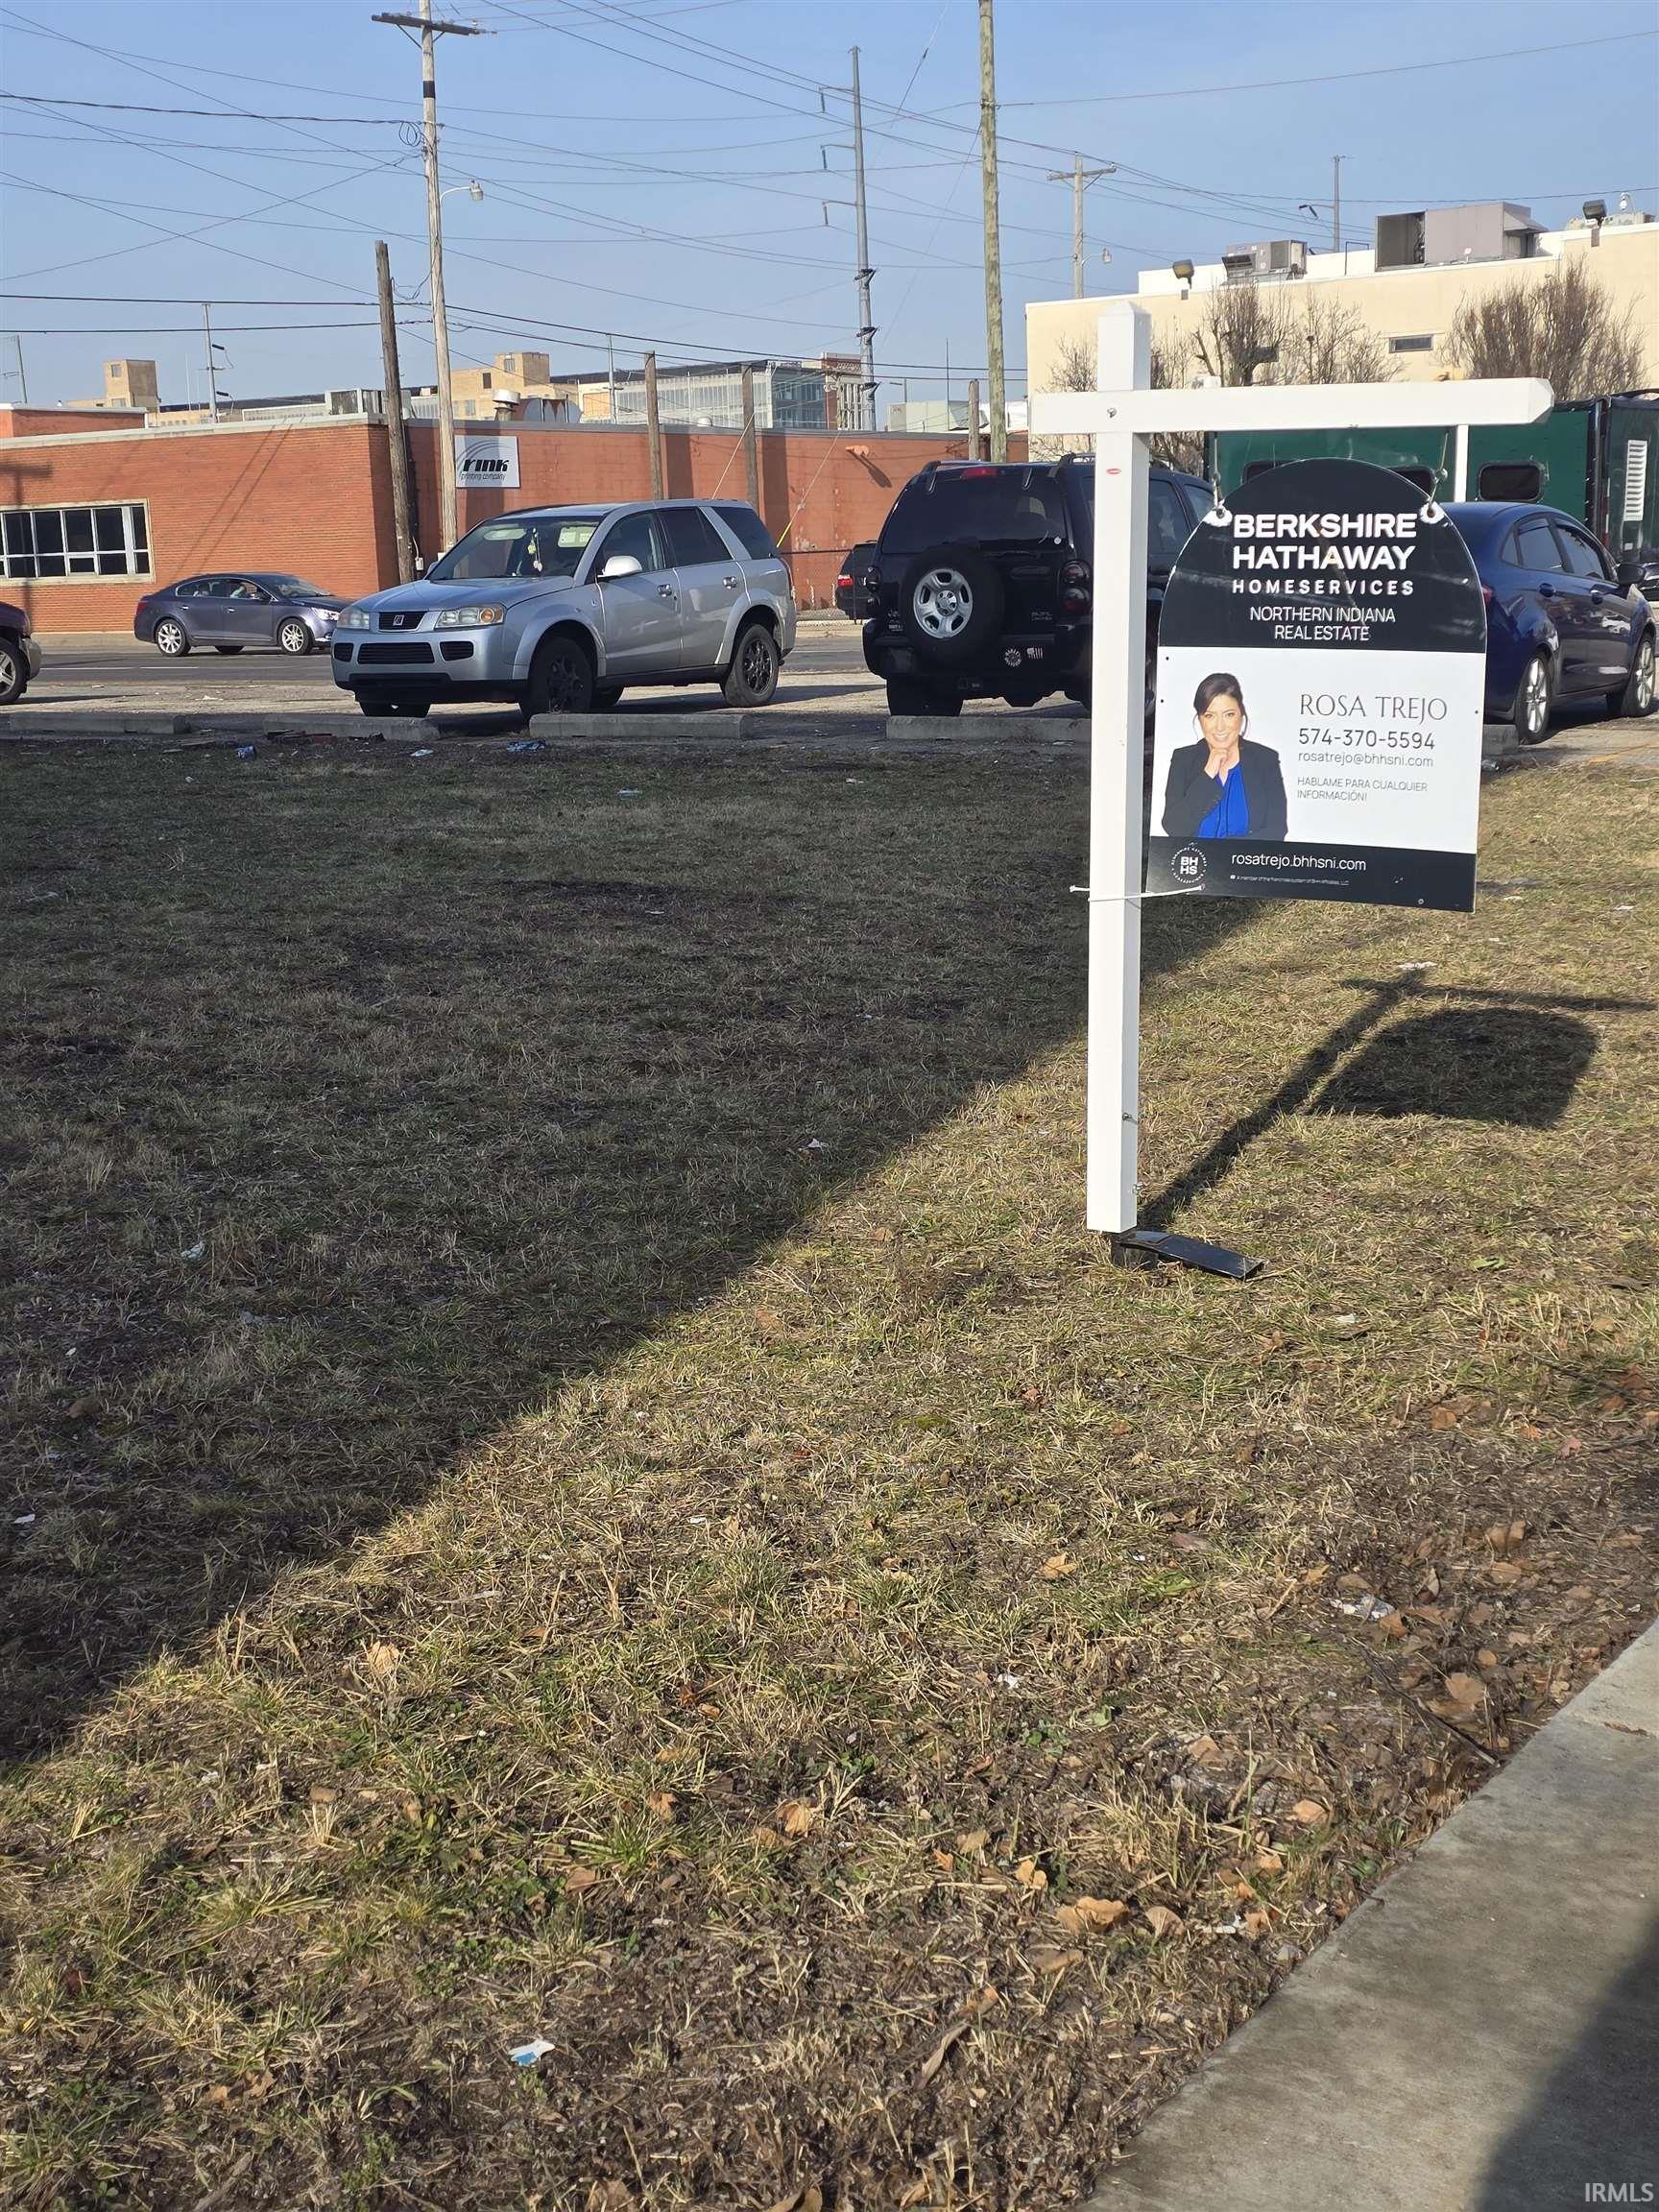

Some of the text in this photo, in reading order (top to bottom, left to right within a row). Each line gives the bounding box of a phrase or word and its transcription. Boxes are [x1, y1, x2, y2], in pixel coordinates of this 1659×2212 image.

[1234, 514, 1417, 539] BERKSHIRE
[1233, 545, 1416, 570] HATHAWAY
[1233, 579, 1414, 596] HOMESERVICES
[1250, 607, 1396, 623] NORTHERN INDIANA
[1300, 693, 1448, 725] ROSA TREJO
[1298, 728, 1436, 750] 574-370-5594
[1298, 752, 1434, 768] rosatrejo@bhhsni.com
[1345, 779, 1371, 788] PARA
[1372, 780, 1428, 792] CUALQUIER
[1181, 856, 1199, 866] BH
[1231, 854, 1366, 871] rosatrejo.bhhsni.com
[1180, 865, 1198, 876] HS
